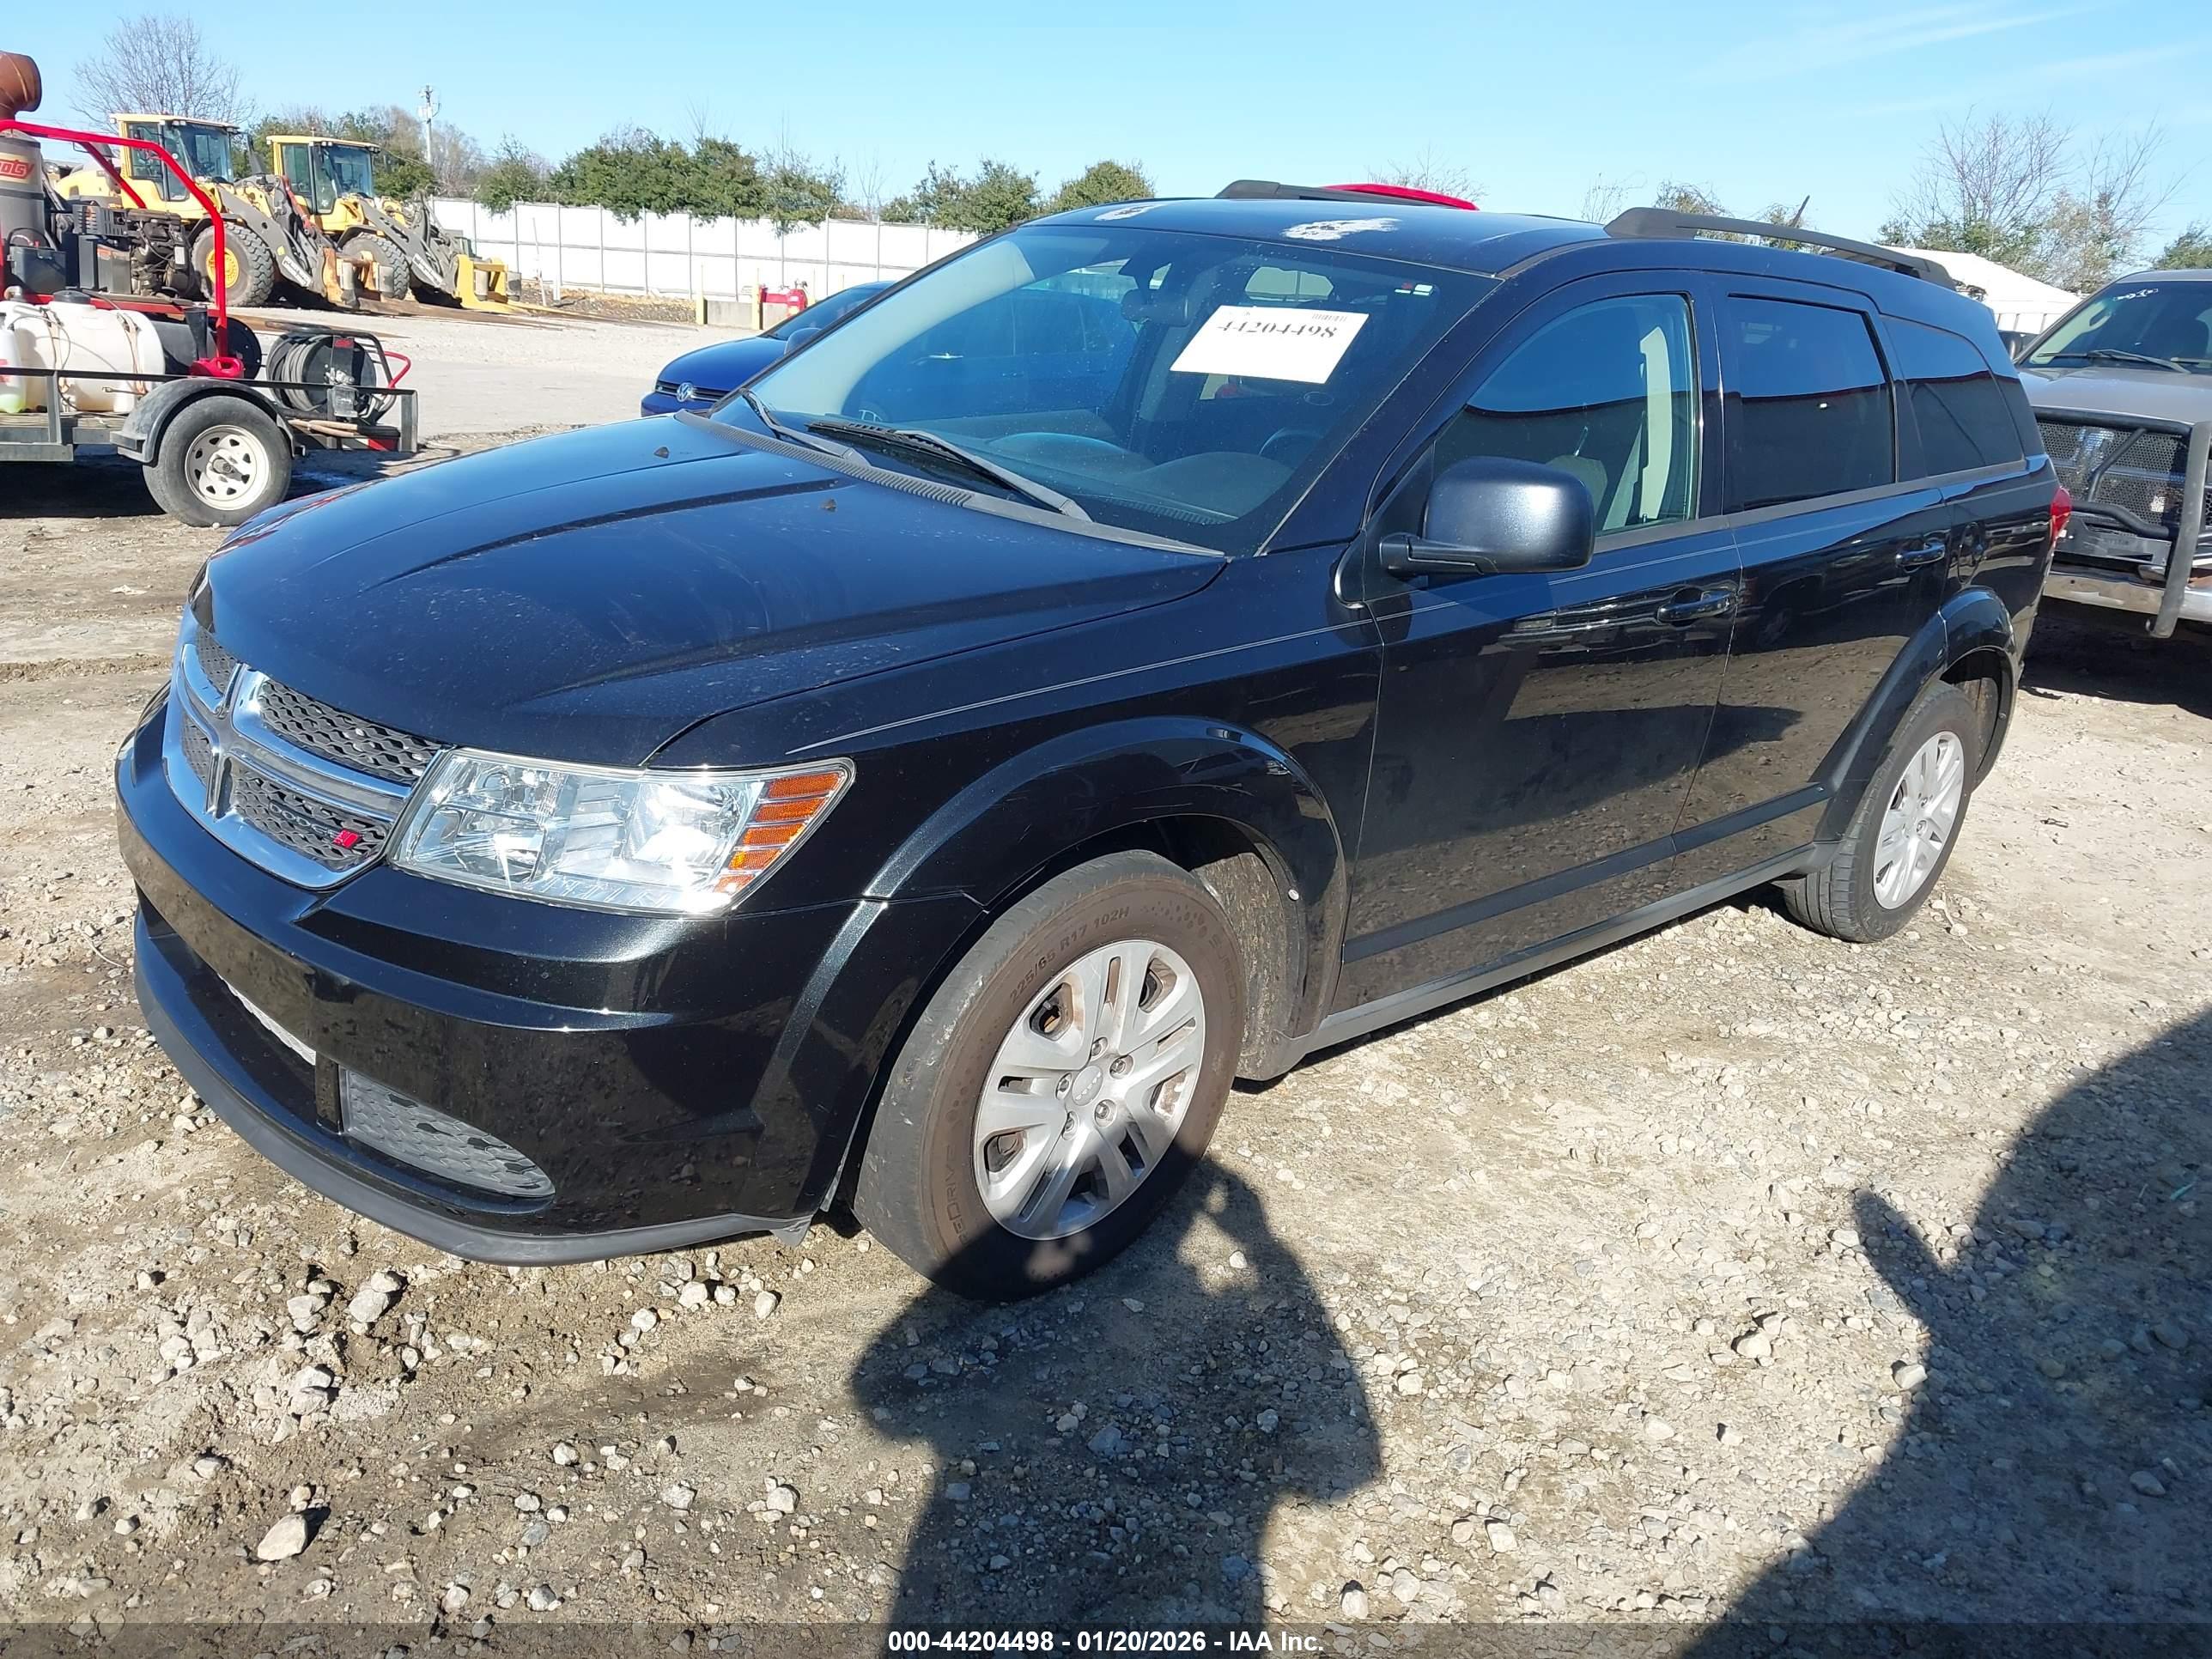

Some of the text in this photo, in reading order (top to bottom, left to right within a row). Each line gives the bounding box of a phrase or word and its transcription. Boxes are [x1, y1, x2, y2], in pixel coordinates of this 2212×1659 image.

[1218, 320, 1337, 337] 44204498
[1010, 907, 1130, 1003] 225/65 R17 102H
